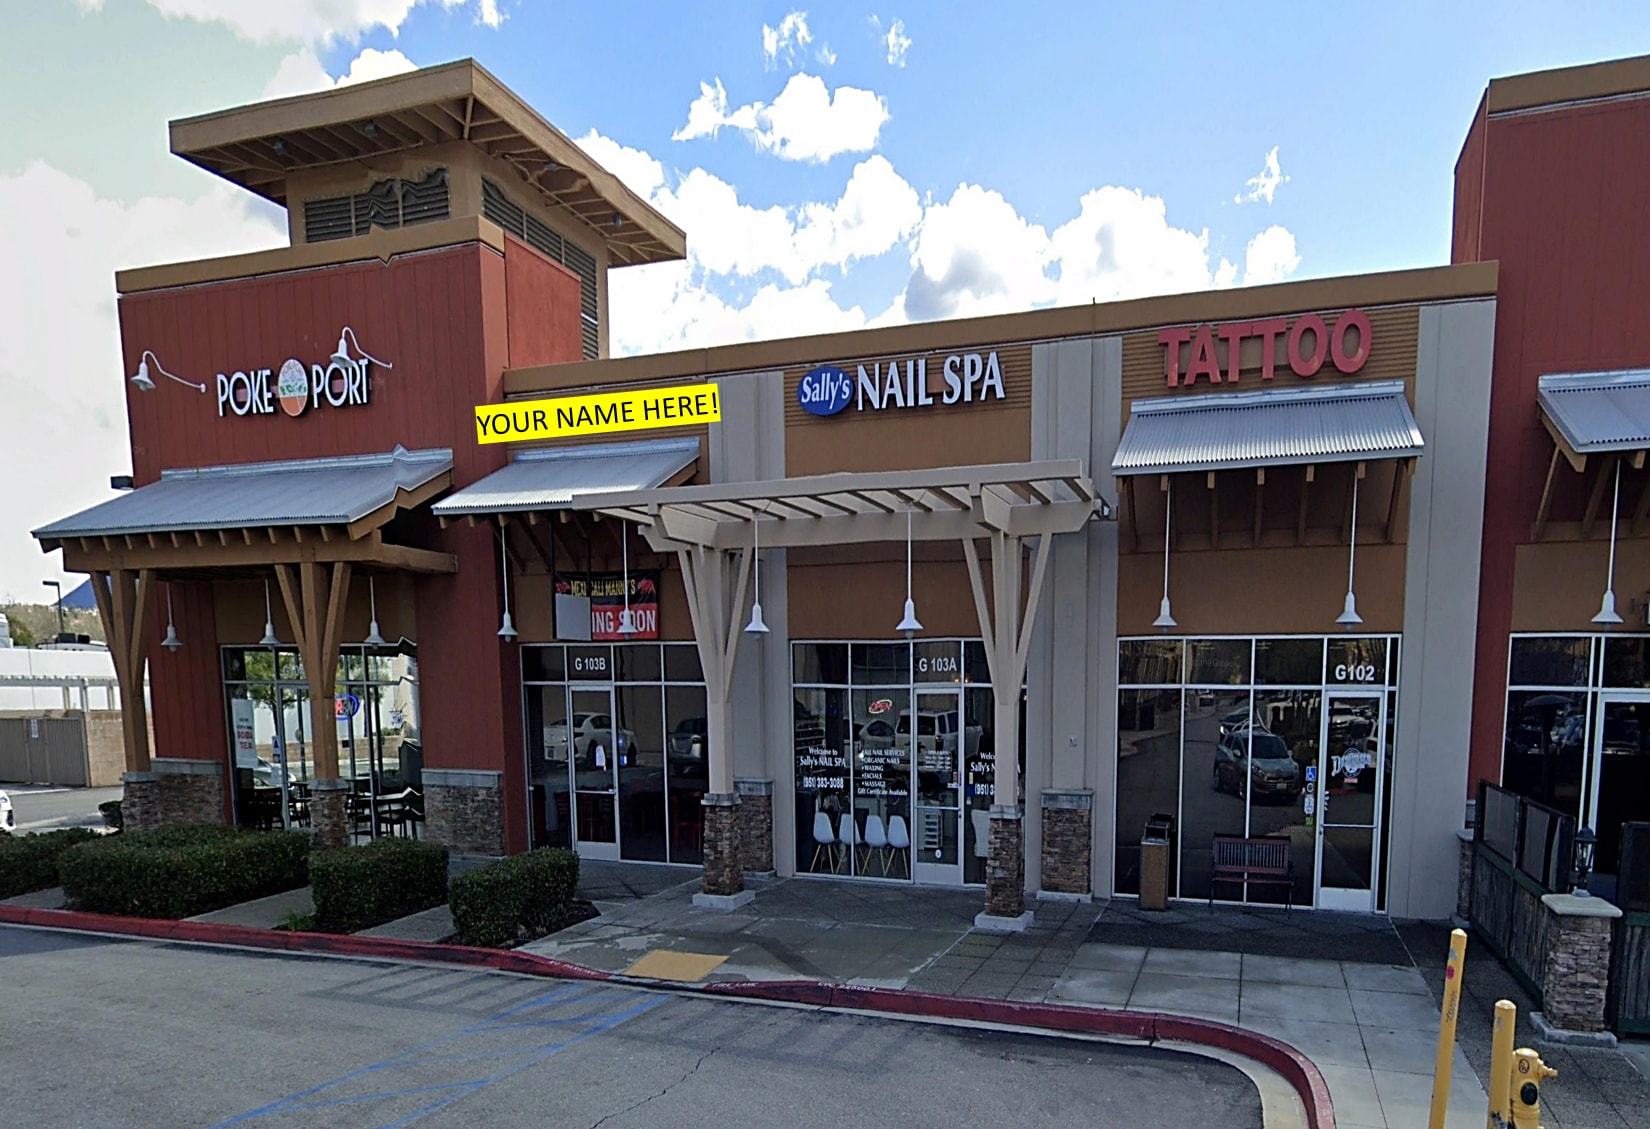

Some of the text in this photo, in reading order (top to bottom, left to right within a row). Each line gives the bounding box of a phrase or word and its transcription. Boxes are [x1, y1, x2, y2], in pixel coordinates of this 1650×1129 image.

[1157, 309, 1373, 388] TATTOO
[216, 358, 369, 417] POKE PORT
[801, 351, 1006, 411] Sally's NAIL SPA
[574, 657, 606, 671] G 103B
[918, 657, 957, 672] G 103A
[1335, 664, 1375, 681] G102
[800, 755, 818, 769] Sally's
[819, 756, 833, 767] NAIL
[970, 761, 990, 775] Sally's
